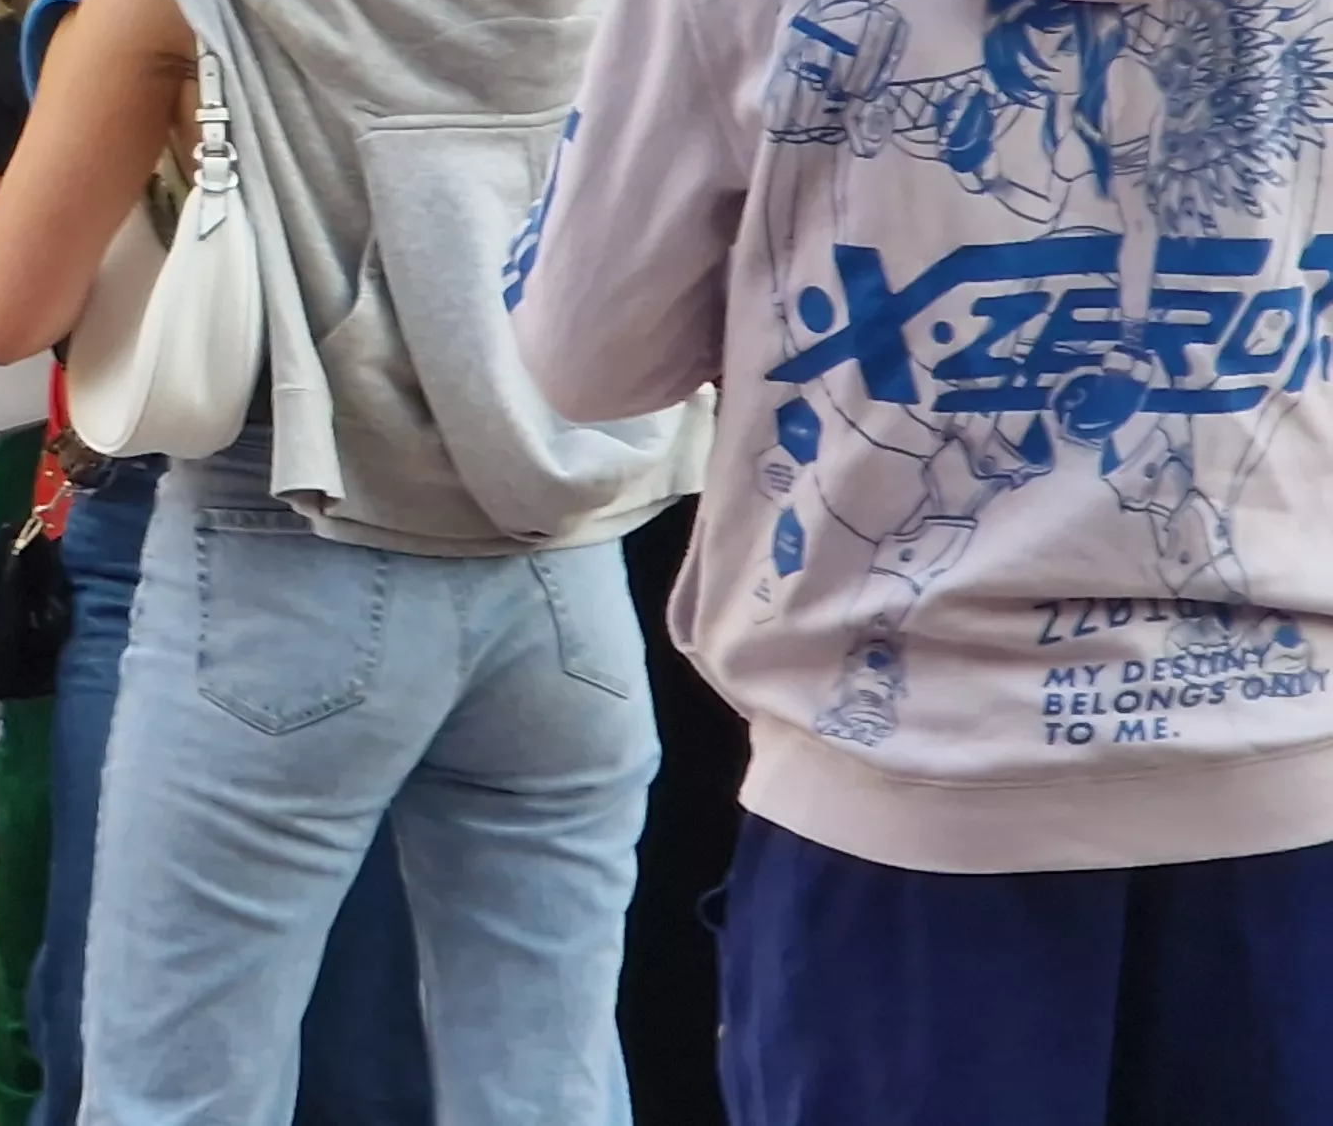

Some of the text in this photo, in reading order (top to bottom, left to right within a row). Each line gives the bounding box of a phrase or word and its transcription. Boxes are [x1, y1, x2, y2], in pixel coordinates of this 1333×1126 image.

[1042, 663, 1107, 689] MY
[1042, 680, 1228, 716] BELONGS
[1042, 717, 1181, 746] TO ME.
